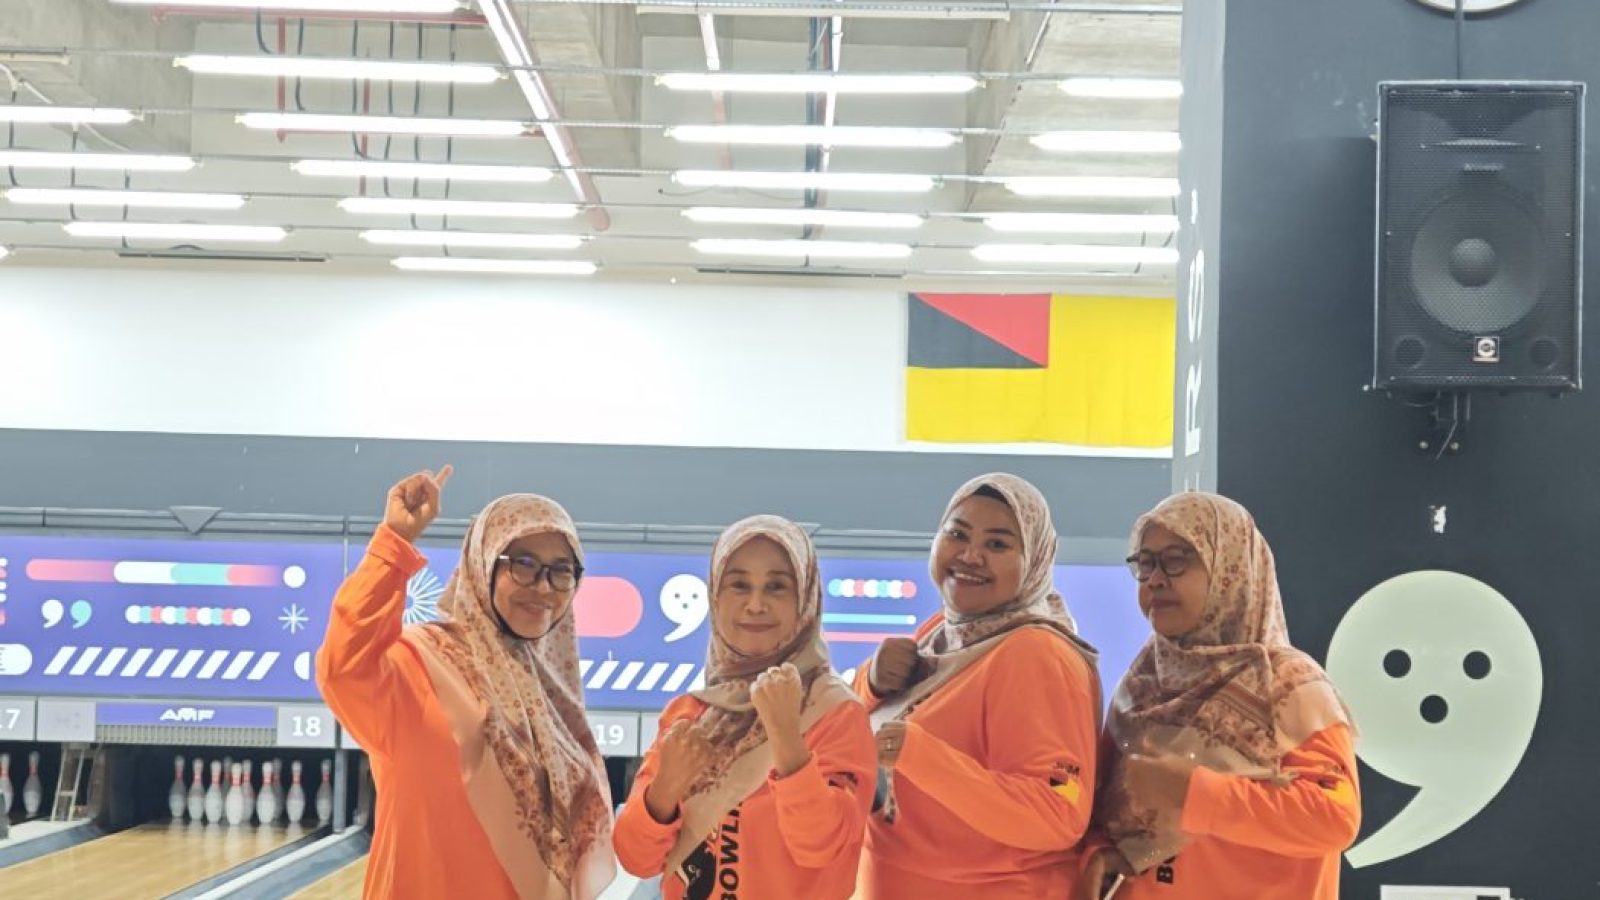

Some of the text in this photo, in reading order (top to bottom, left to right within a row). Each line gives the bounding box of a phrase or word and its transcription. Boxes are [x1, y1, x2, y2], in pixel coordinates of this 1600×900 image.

[1184, 189, 1205, 492] RS-
[0, 708, 21, 730] 7
[160, 708, 215, 721] AMF
[292, 715, 321, 736] 18
[595, 723, 624, 745] 19
